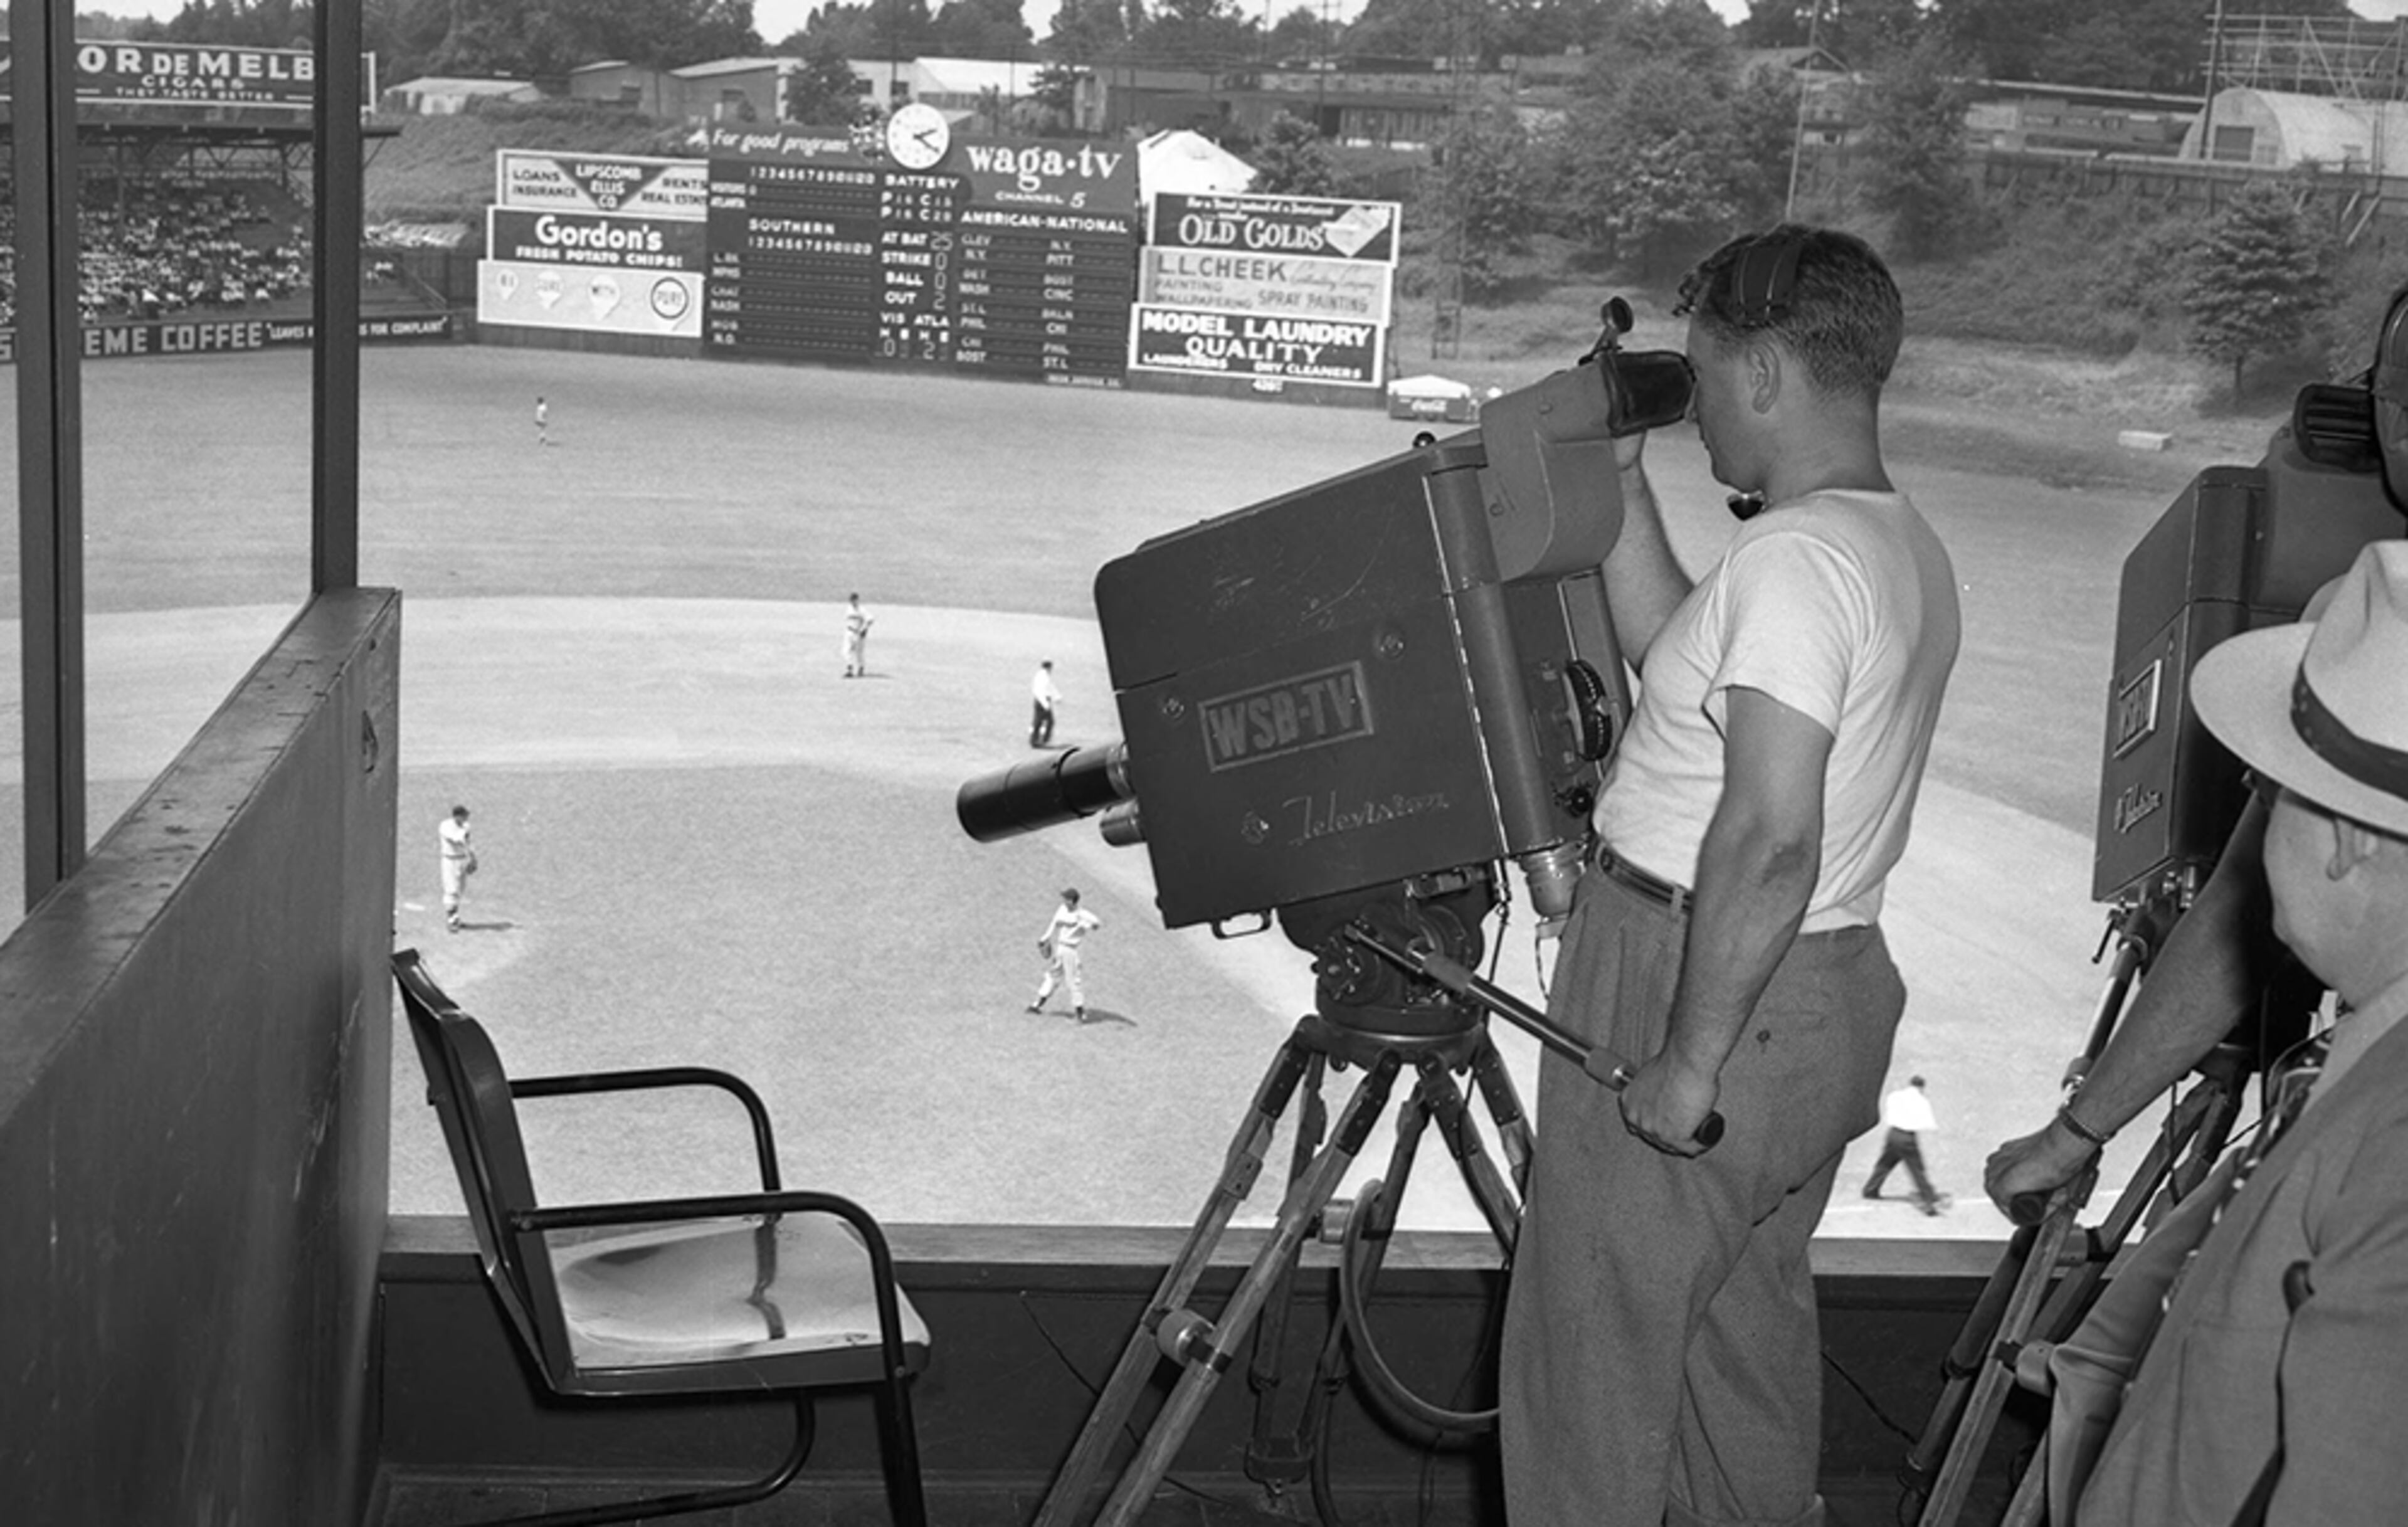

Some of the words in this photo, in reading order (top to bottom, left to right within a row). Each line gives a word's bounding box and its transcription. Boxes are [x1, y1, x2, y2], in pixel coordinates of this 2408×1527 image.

[154, 53, 189, 76] DE
[142, 74, 245, 89] CIGARS
[713, 128, 740, 145] For
[740, 132, 781, 154] good
[781, 137, 848, 157] programs
[513, 170, 561, 181] LOANS
[576, 164, 642, 181] LIPSCOMB
[885, 173, 959, 189] BATTERY
[513, 186, 577, 199] INSURANCE
[591, 181, 625, 195] ELLIS
[642, 192, 670, 204] REAL
[882, 191, 892, 203] P
[920, 194, 931, 206] C
[995, 191, 1064, 204] CHANNEL
[1070, 192, 1086, 208] 5
[882, 206, 892, 218] P
[919, 208, 930, 221] C
[961, 211, 1127, 233] AMERICAN-NATIONAL
[535, 215, 662, 251] Gordon's
[749, 218, 835, 235] SOUTHERN
[1179, 213, 1236, 245] OLD
[1244, 217, 1324, 251] GOLDS
[882, 231, 899, 243] AT
[901, 232, 928, 245] BAT
[516, 245, 560, 260] FRESH
[566, 248, 620, 263] POTATO
[626, 253, 682, 268] CHIPS!
[882, 251, 931, 266] STRIKE
[935, 251, 948, 270] 0
[1200, 256, 1287, 282] CHEEK
[885, 271, 924, 286] BALL
[934, 272, 946, 290] 0
[1154, 279, 1222, 292] PAINTING
[885, 291, 917, 304] OUT
[933, 291, 945, 310] 2
[1258, 290, 1301, 306] SPRAY
[1307, 292, 1370, 313] PAINTING
[880, 312, 905, 324] VIS
[914, 315, 949, 327] ATLA
[1143, 310, 1233, 336] MODEL
[1245, 319, 1371, 346] LAUNDRY
[161, 322, 263, 352] COFFEE
[884, 338, 895, 356] 0
[923, 341, 935, 359] 2
[1185, 337, 1323, 363] QUALITY
[1287, 363, 1362, 379] CLEANERS
[1209, 674, 1354, 758] WSB-TV
[1282, 791, 1449, 847] Television
